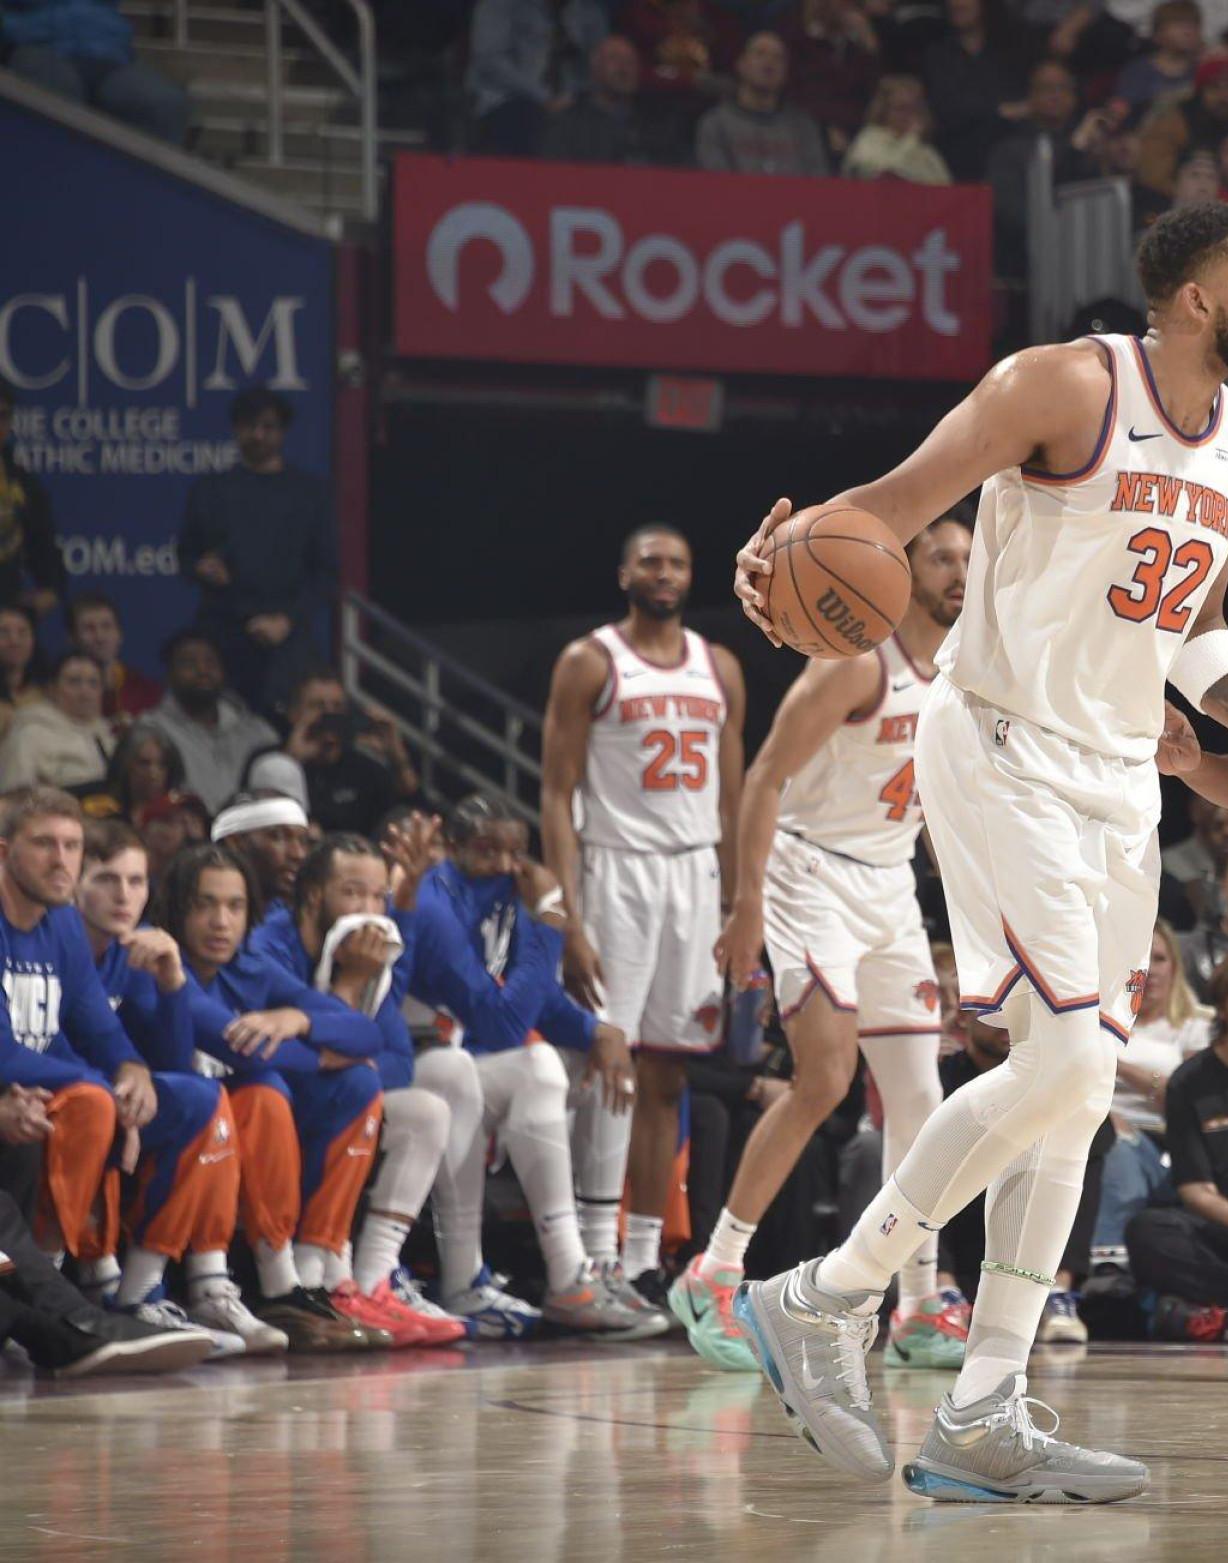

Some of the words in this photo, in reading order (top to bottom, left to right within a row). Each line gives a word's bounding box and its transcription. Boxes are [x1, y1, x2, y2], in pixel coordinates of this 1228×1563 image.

[550, 206, 961, 337] Rocket
[53, 406, 180, 441] COLLEGE
[1110, 470, 1184, 518] NEW
[55, 535, 180, 577] OM.ed
[1106, 526, 1214, 634] 32
[641, 729, 709, 792] 25
[878, 756, 926, 822] 4
